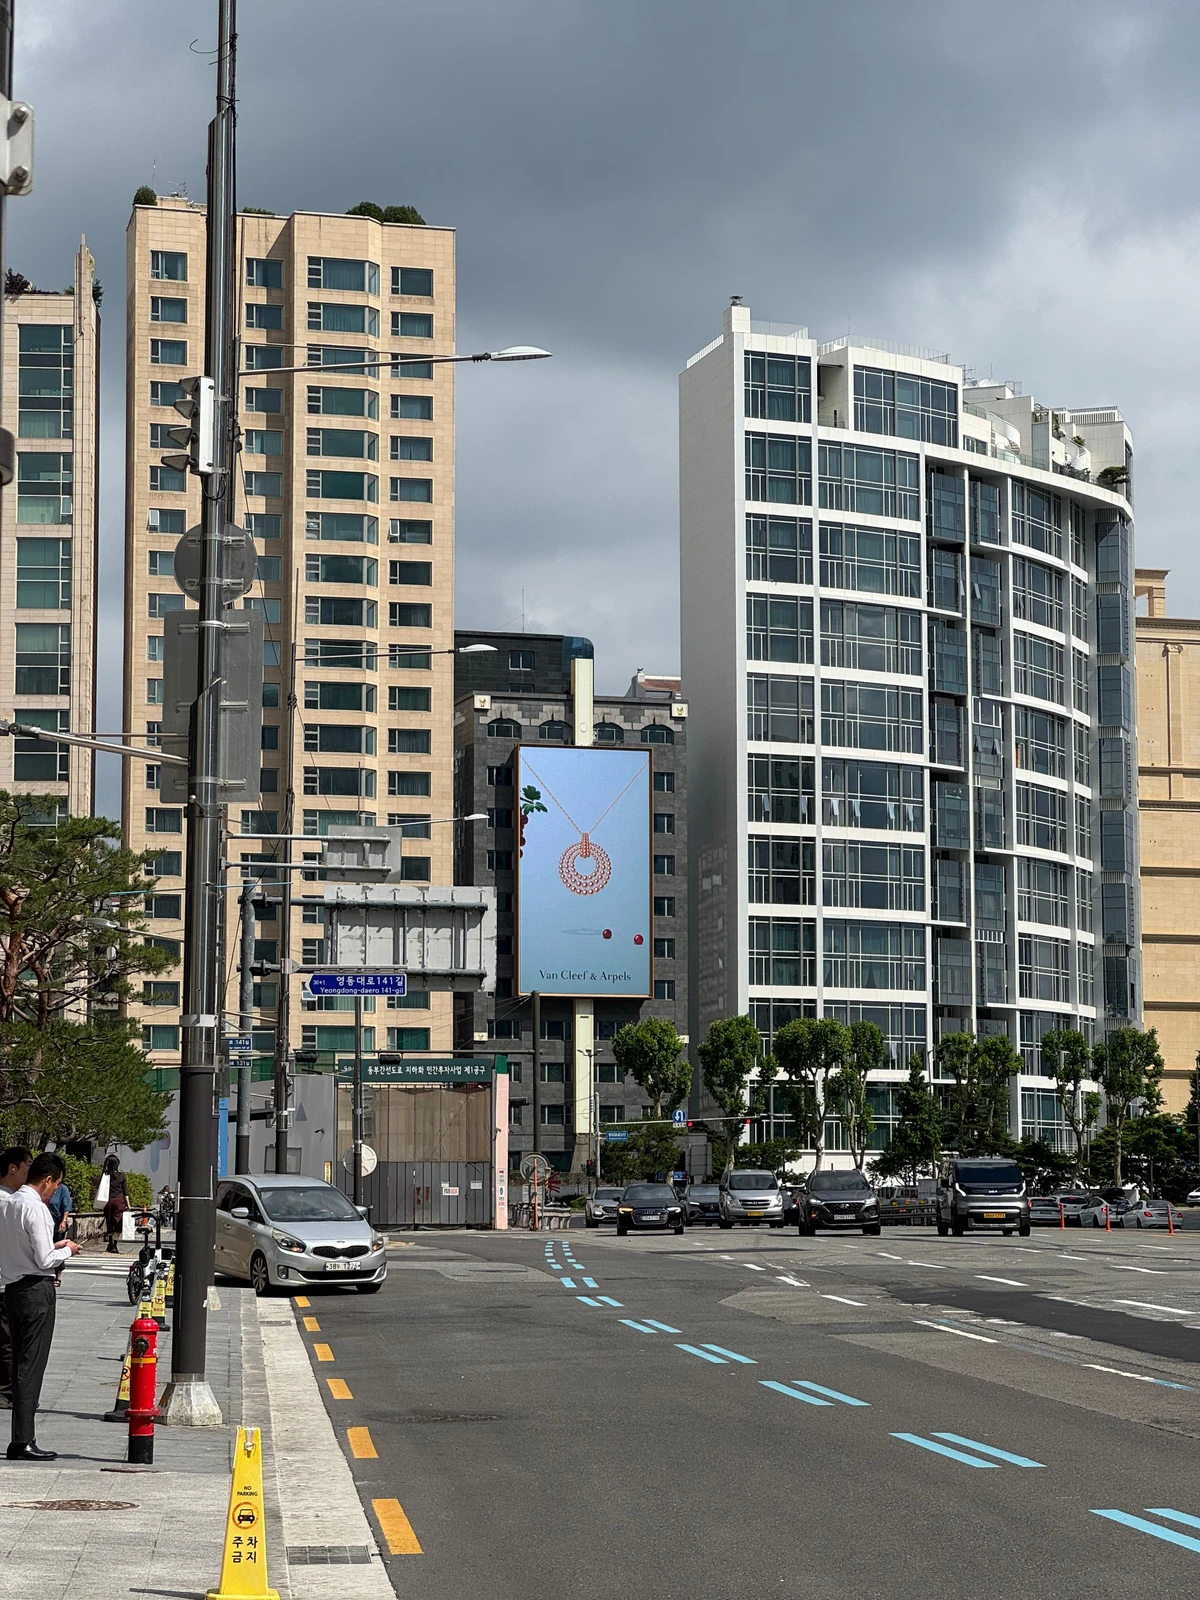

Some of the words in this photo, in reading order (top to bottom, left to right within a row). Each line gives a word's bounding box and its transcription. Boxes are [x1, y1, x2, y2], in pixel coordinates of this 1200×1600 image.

[336, 976, 404, 986] 영동대로141길
[539, 970, 558, 980] Van
[560, 970, 588, 980] Cleef
[600, 971, 631, 984] Arpels
[320, 987, 380, 995] Yeongdong-daero
[381, 987, 404, 995] 141-gil
[367, 1066, 403, 1075] 동부간선도로
[406, 1066, 425, 1075] 지하화
[464, 1066, 486, 1075] 제1공구
